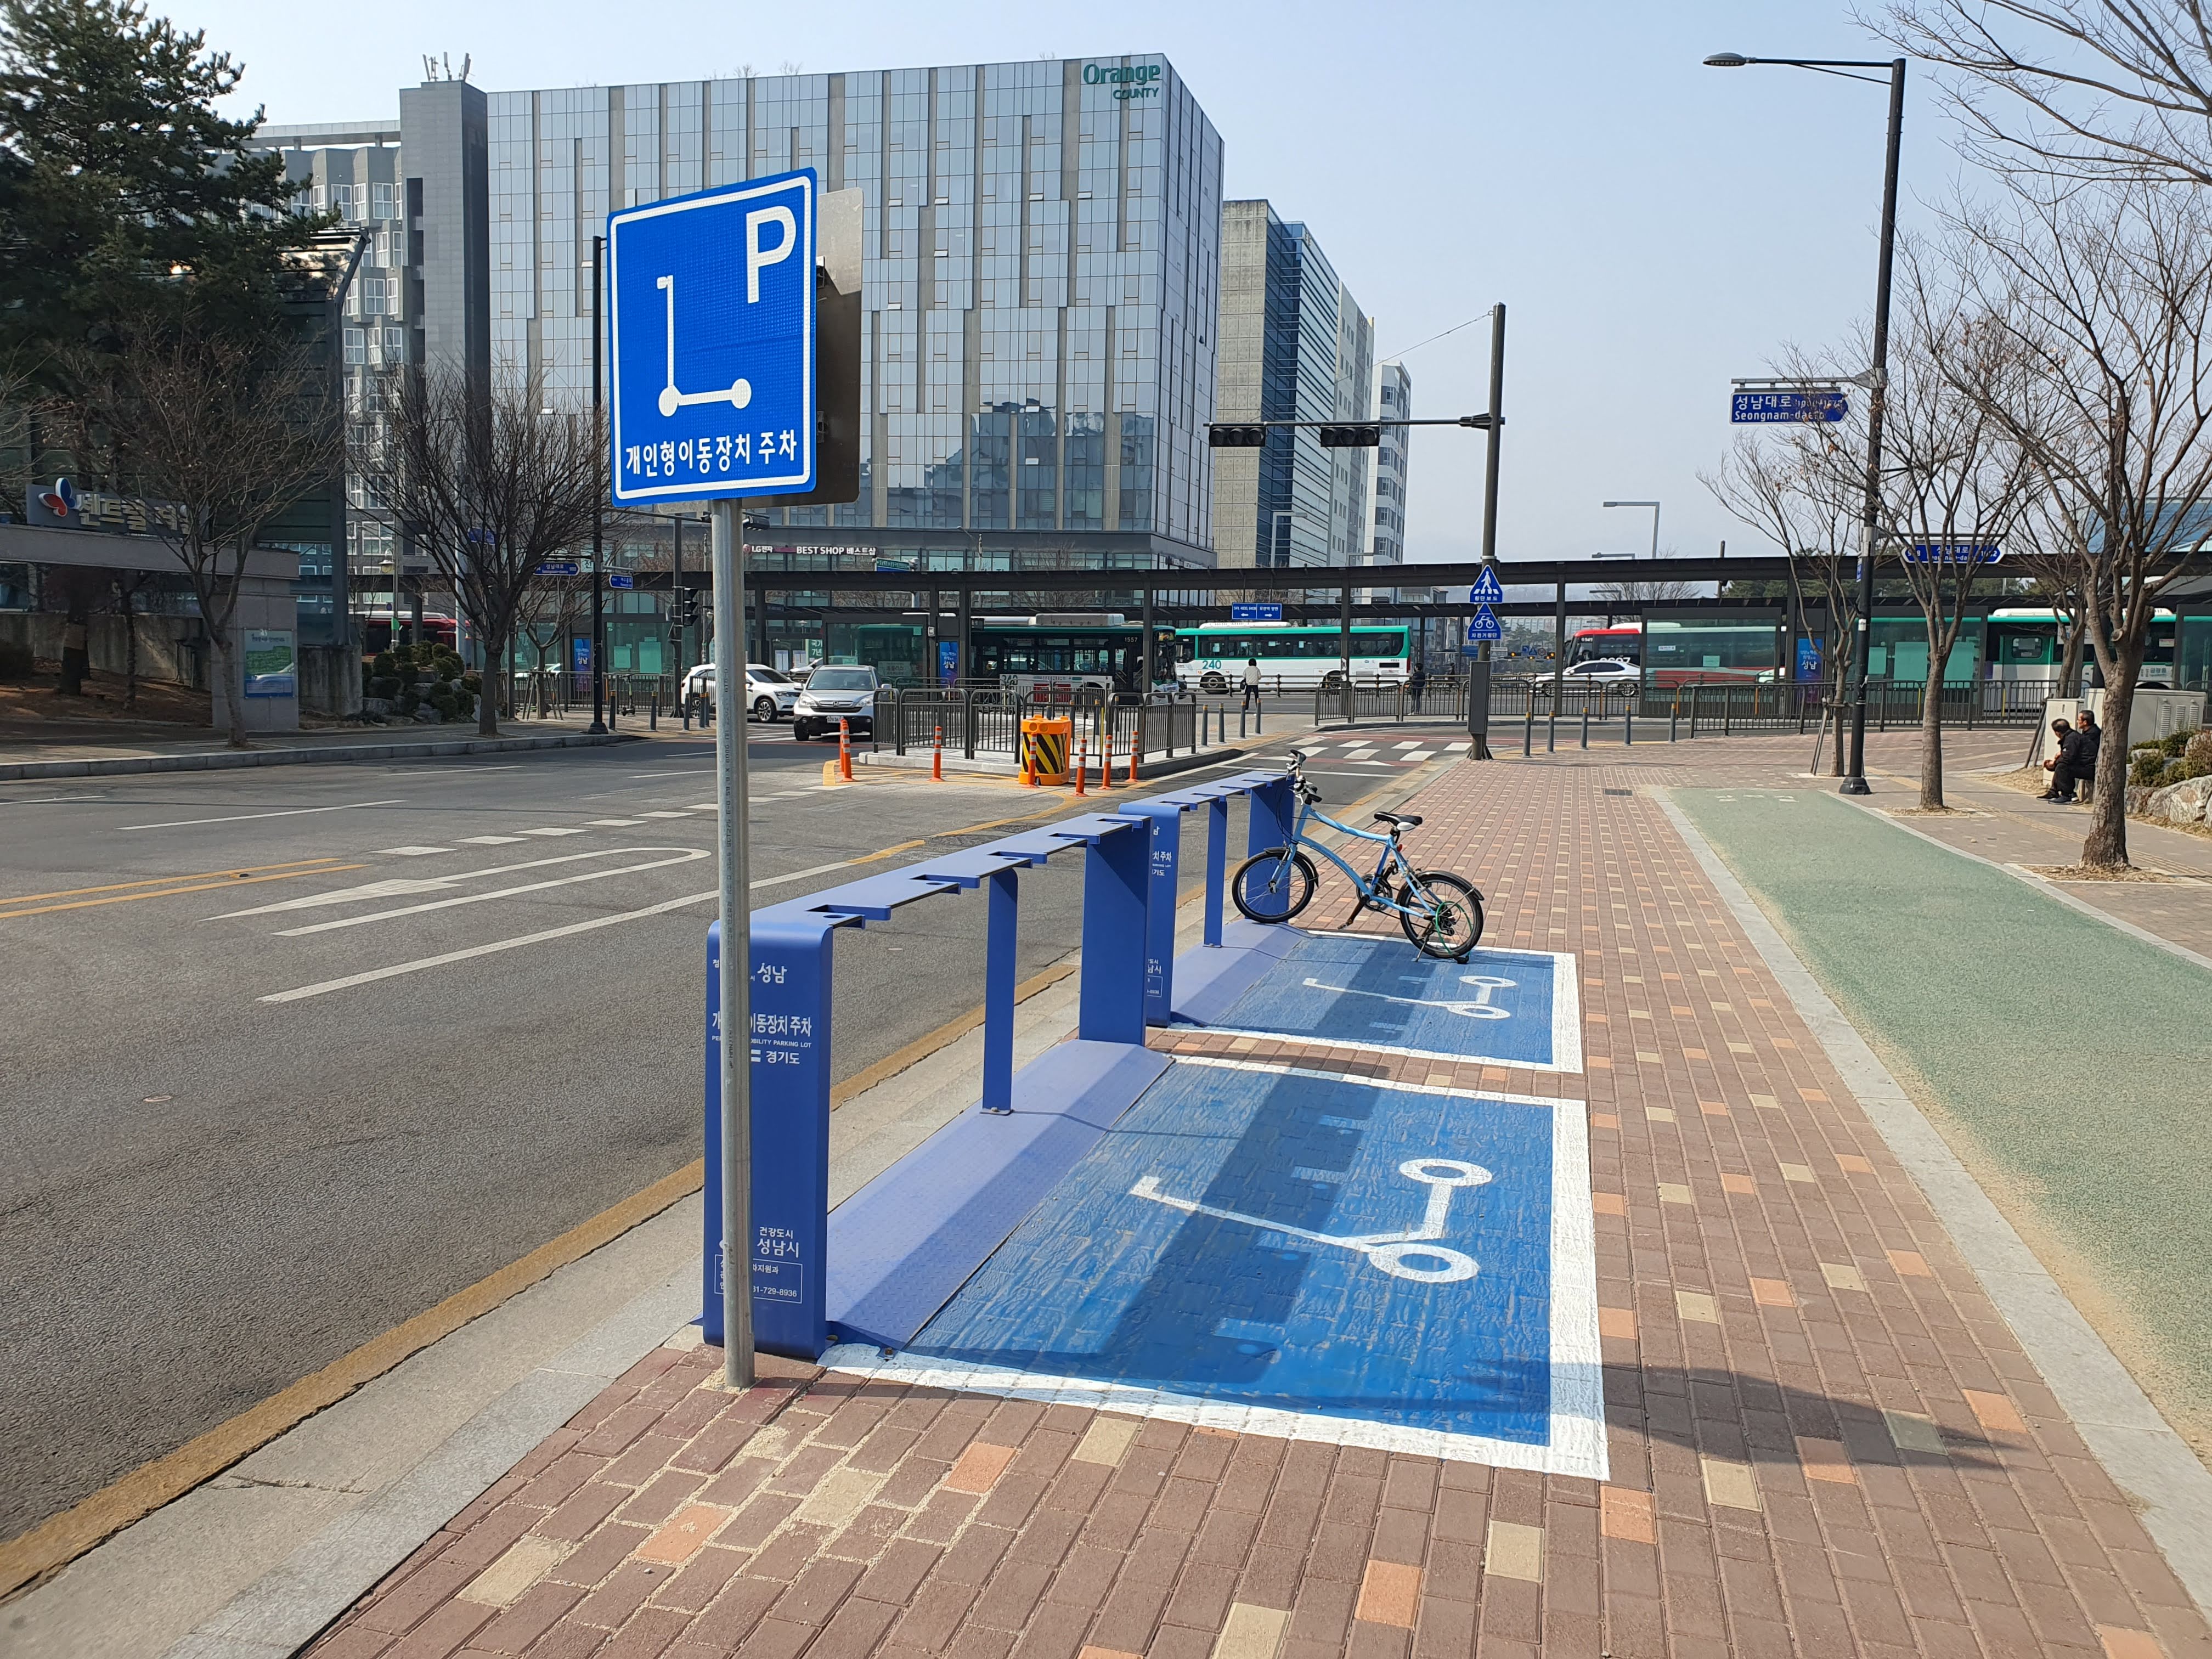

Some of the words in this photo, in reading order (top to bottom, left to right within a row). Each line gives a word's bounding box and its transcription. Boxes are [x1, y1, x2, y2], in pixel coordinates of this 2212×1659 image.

[1084, 64, 1160, 85] Orange
[1113, 87, 1159, 99] COUNTY
[746, 205, 797, 303] P
[1736, 395, 1792, 410] 성남대로
[626, 433, 751, 477] 개인형이동장치
[758, 430, 797, 464] 주차
[820, 546, 845, 555] SHOP
[847, 548, 876, 556] 베스트샵
[943, 660, 955, 669] 성남
[1202, 660, 1222, 669] 240
[1801, 659, 1817, 669] 성남
[1160, 851, 1172, 862] 주차
[757, 962, 787, 984] 성남
[1148, 964, 1161, 974] 남시
[790, 1016, 811, 1037] 주차
[766, 1051, 800, 1064] 경기도
[759, 1227, 793, 1239] 건강도시
[757, 1238, 799, 1257] 성남시
[753, 1285, 797, 1297] 31-729-8936
